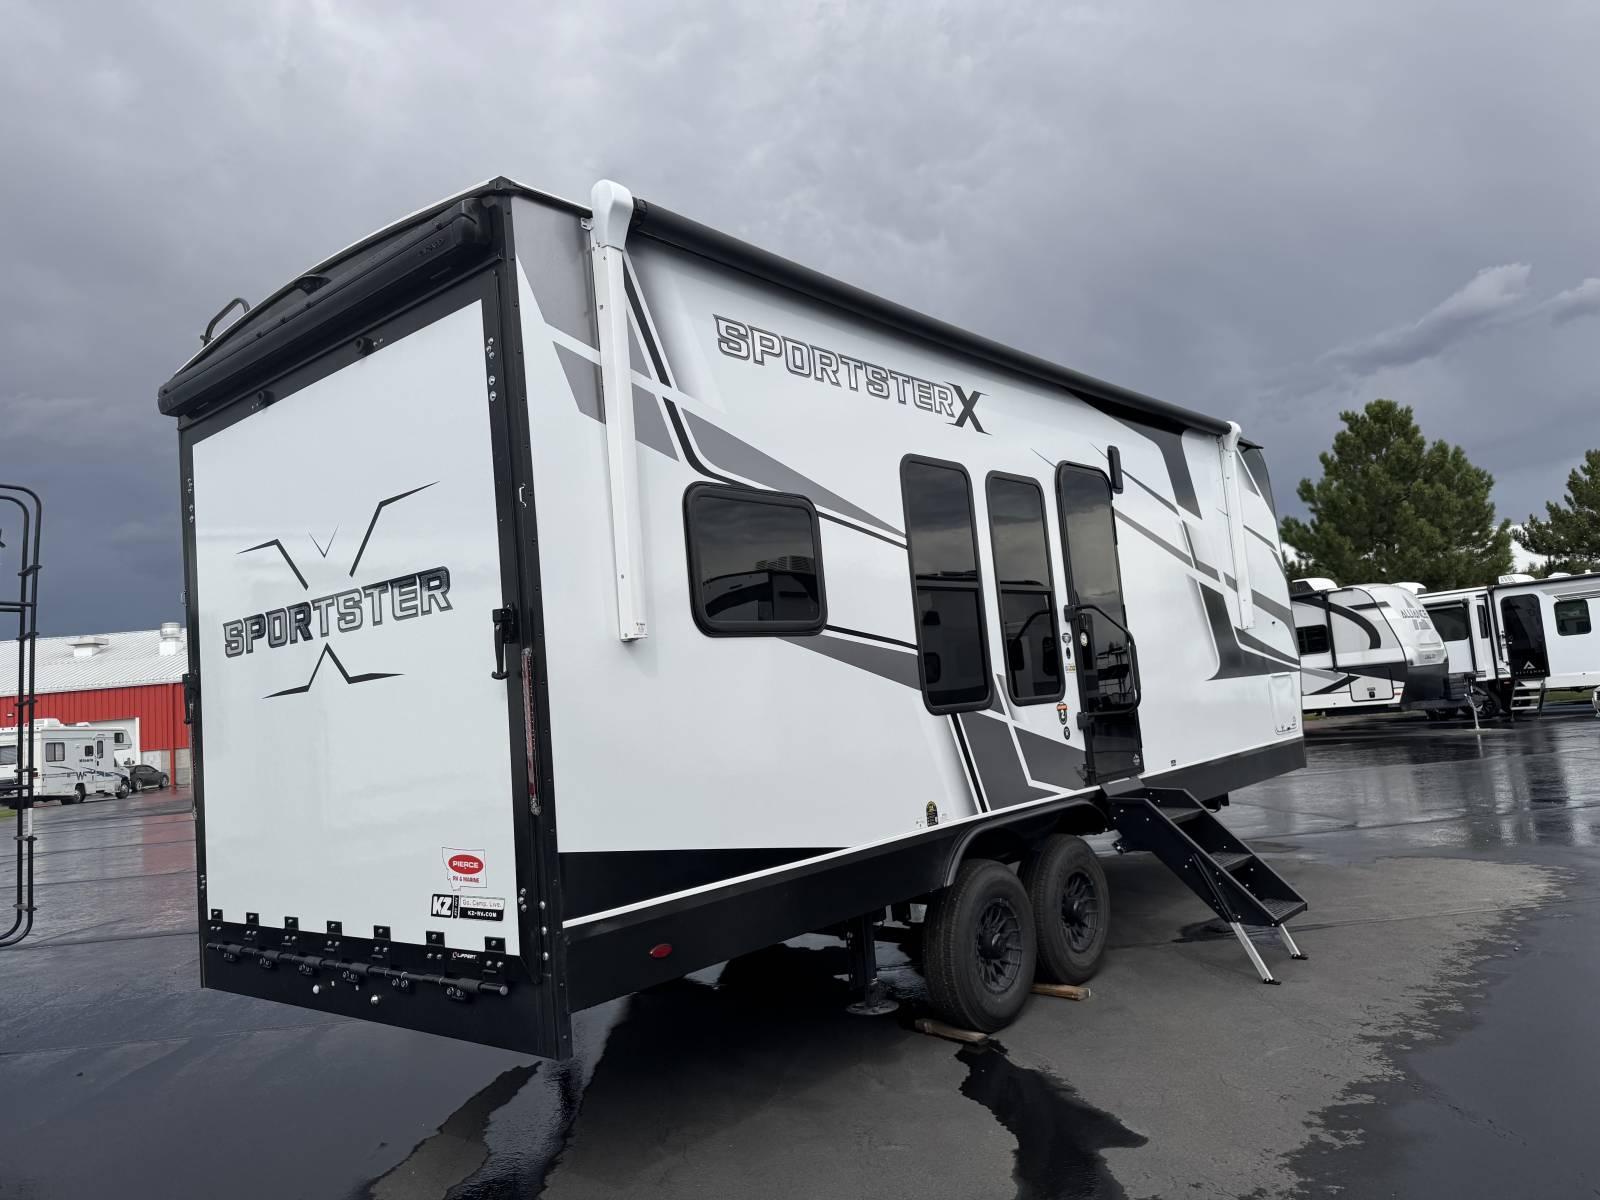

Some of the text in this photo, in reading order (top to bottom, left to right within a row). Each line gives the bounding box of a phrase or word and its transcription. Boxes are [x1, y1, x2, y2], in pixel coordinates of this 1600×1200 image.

[222, 565, 453, 658] SPORTSTER
[452, 860, 479, 869] PIERCE
[432, 896, 452, 916] KZ
